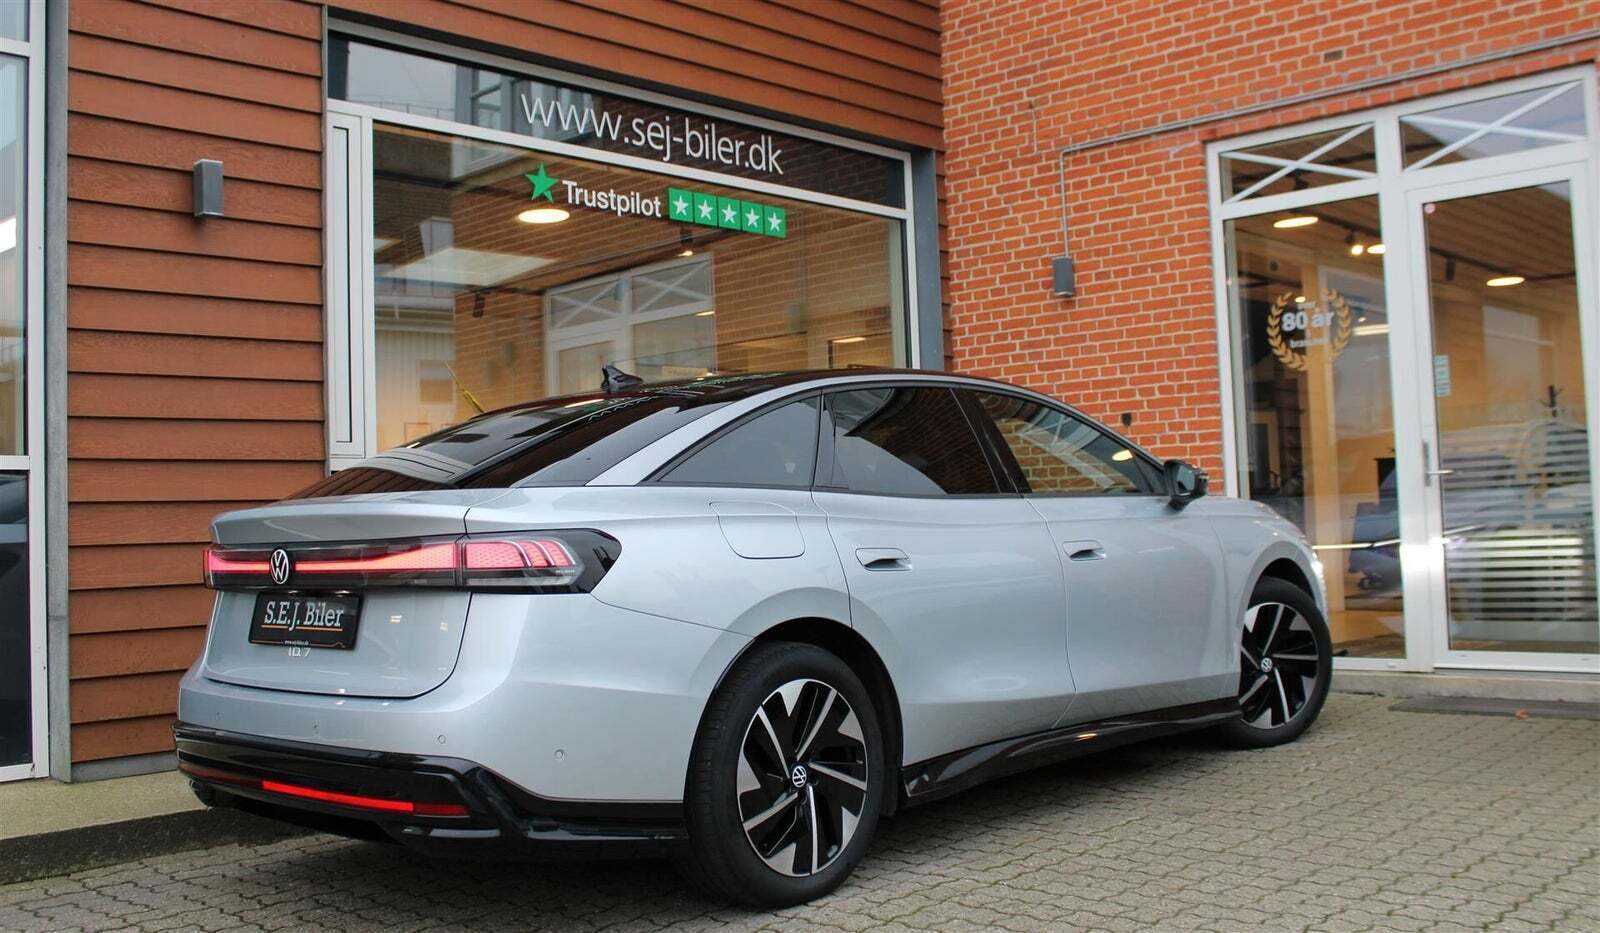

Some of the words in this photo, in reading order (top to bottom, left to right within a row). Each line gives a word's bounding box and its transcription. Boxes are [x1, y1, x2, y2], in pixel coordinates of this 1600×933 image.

[521, 93, 784, 175] www.sej-biler.dk
[562, 179, 662, 218] Trustpilot
[1281, 311, 1308, 332] 80
[264, 600, 300, 631] S.E.J.
[303, 601, 344, 627] Biler
